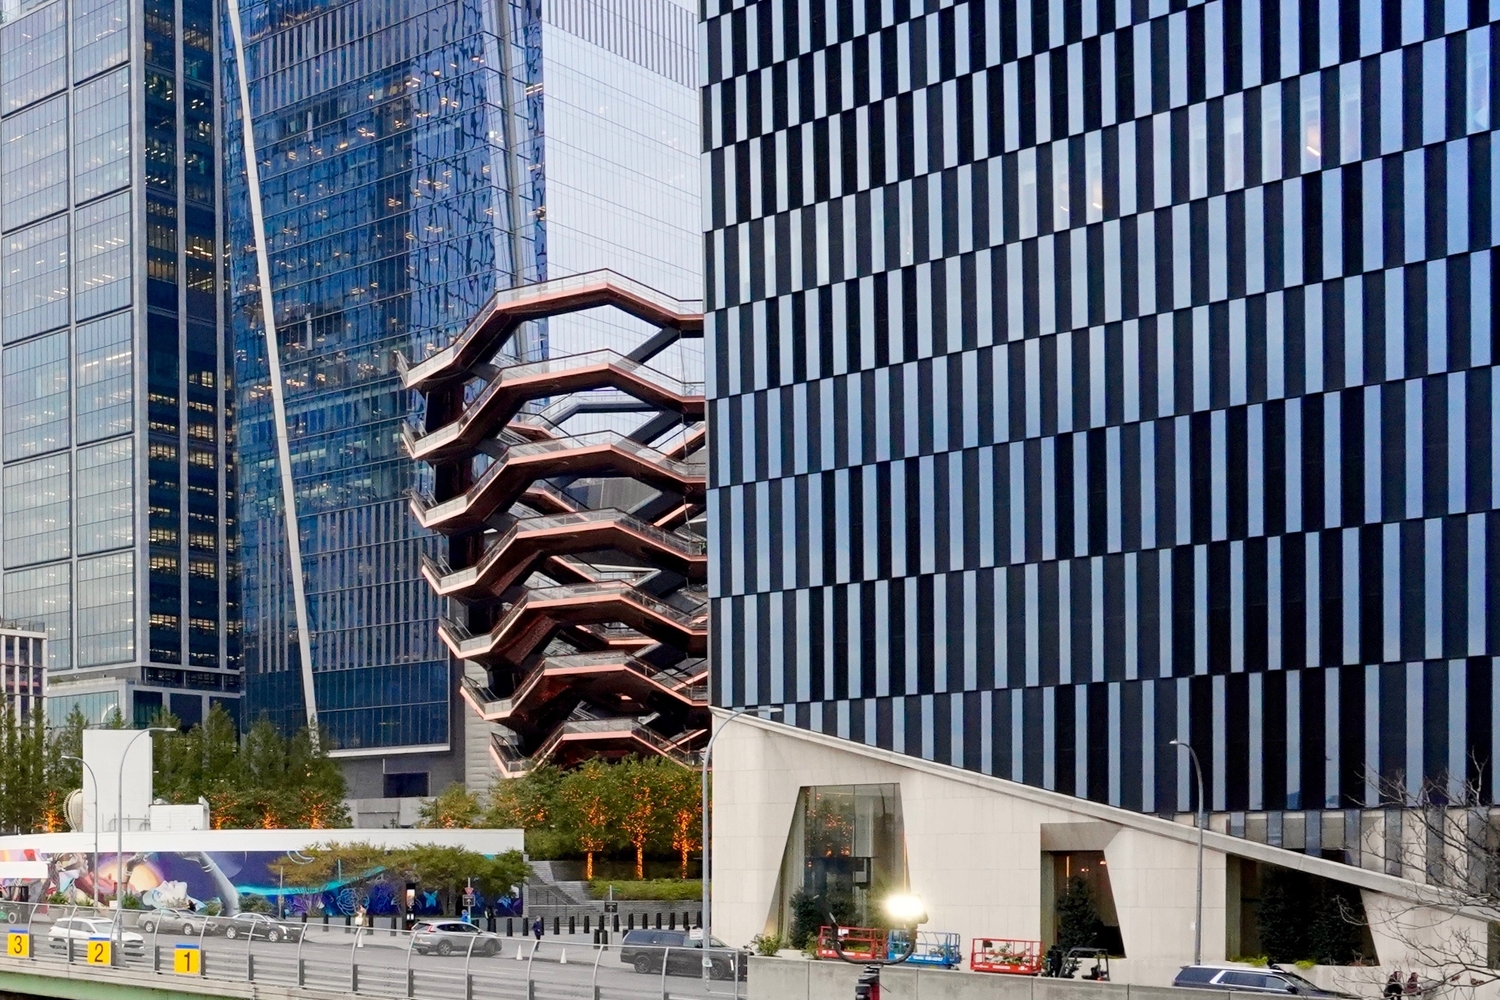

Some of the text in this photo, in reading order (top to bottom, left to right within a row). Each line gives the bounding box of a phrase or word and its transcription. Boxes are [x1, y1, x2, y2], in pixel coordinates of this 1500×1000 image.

[14, 936, 22, 954] 3
[95, 944, 104, 962] 2
[183, 952, 190, 972] 1
